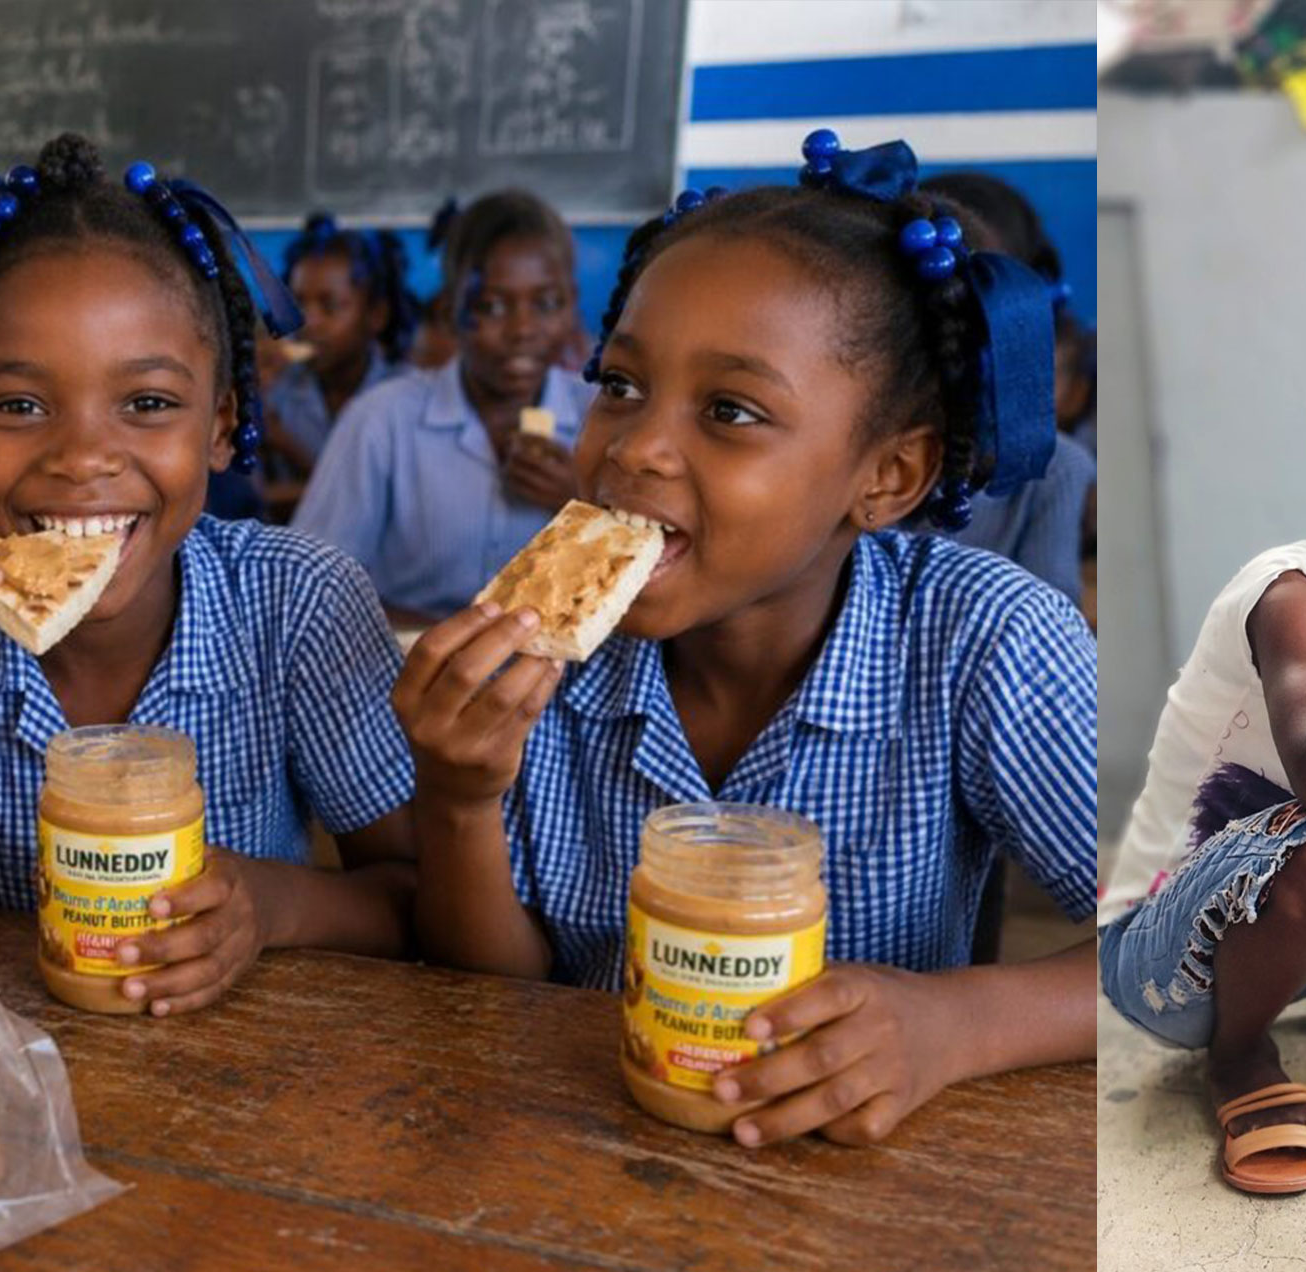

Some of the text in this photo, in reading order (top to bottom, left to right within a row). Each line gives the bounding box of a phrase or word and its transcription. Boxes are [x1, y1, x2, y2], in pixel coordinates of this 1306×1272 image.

[56, 844, 170, 874] LUNNEDDY
[62, 909, 108, 928] PEANUT
[651, 938, 785, 979] LUNNEDDY
[653, 1008, 709, 1038] PEANUT
